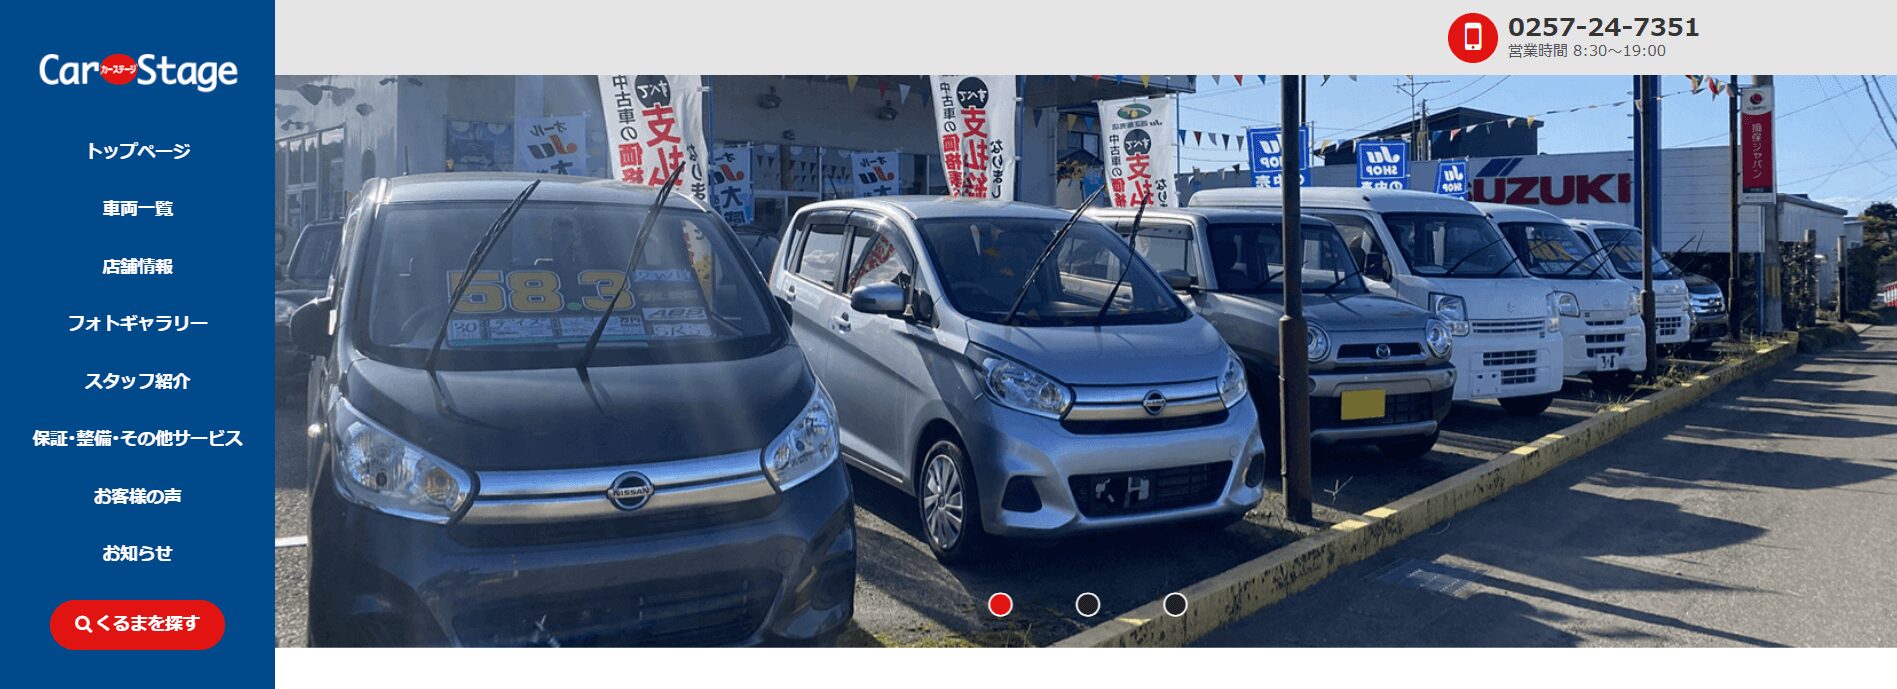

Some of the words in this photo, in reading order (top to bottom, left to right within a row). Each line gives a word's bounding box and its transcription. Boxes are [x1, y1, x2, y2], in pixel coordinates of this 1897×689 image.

[1751, 123, 1763, 179] 損保ジャパン
[446, 269, 636, 313] 58.3
[612, 487, 651, 497] NISSAN
